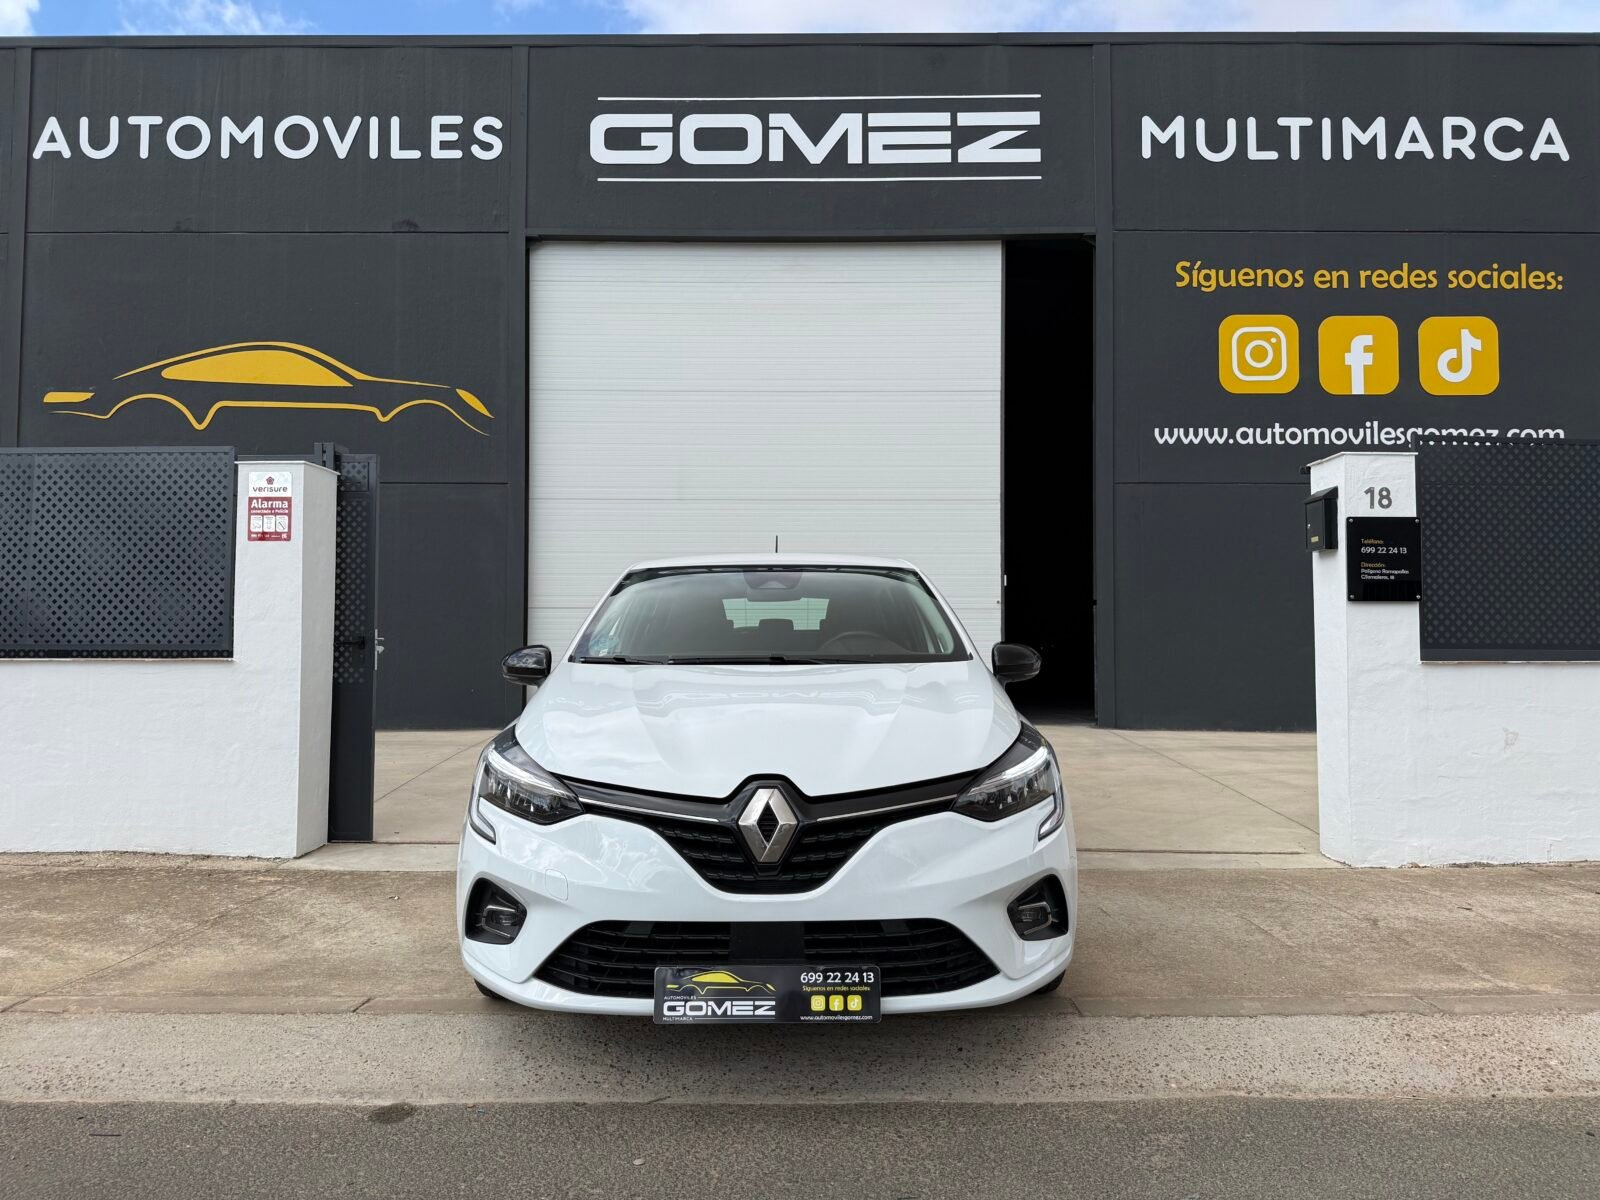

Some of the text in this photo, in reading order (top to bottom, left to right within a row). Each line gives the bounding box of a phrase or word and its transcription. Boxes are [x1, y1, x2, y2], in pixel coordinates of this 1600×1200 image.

[32, 115, 503, 160] AUTOMOVILES
[589, 110, 1042, 164] GOMEZ
[1141, 115, 1570, 162] MULTIMARCA
[1175, 261, 1564, 293] Síguenos en redes sociales:
[251, 499, 288, 509] Alarma
[1364, 486, 1393, 510] 18
[800, 972, 875, 984] 699 22 24 13
[663, 1000, 776, 1016] GOMEZ
